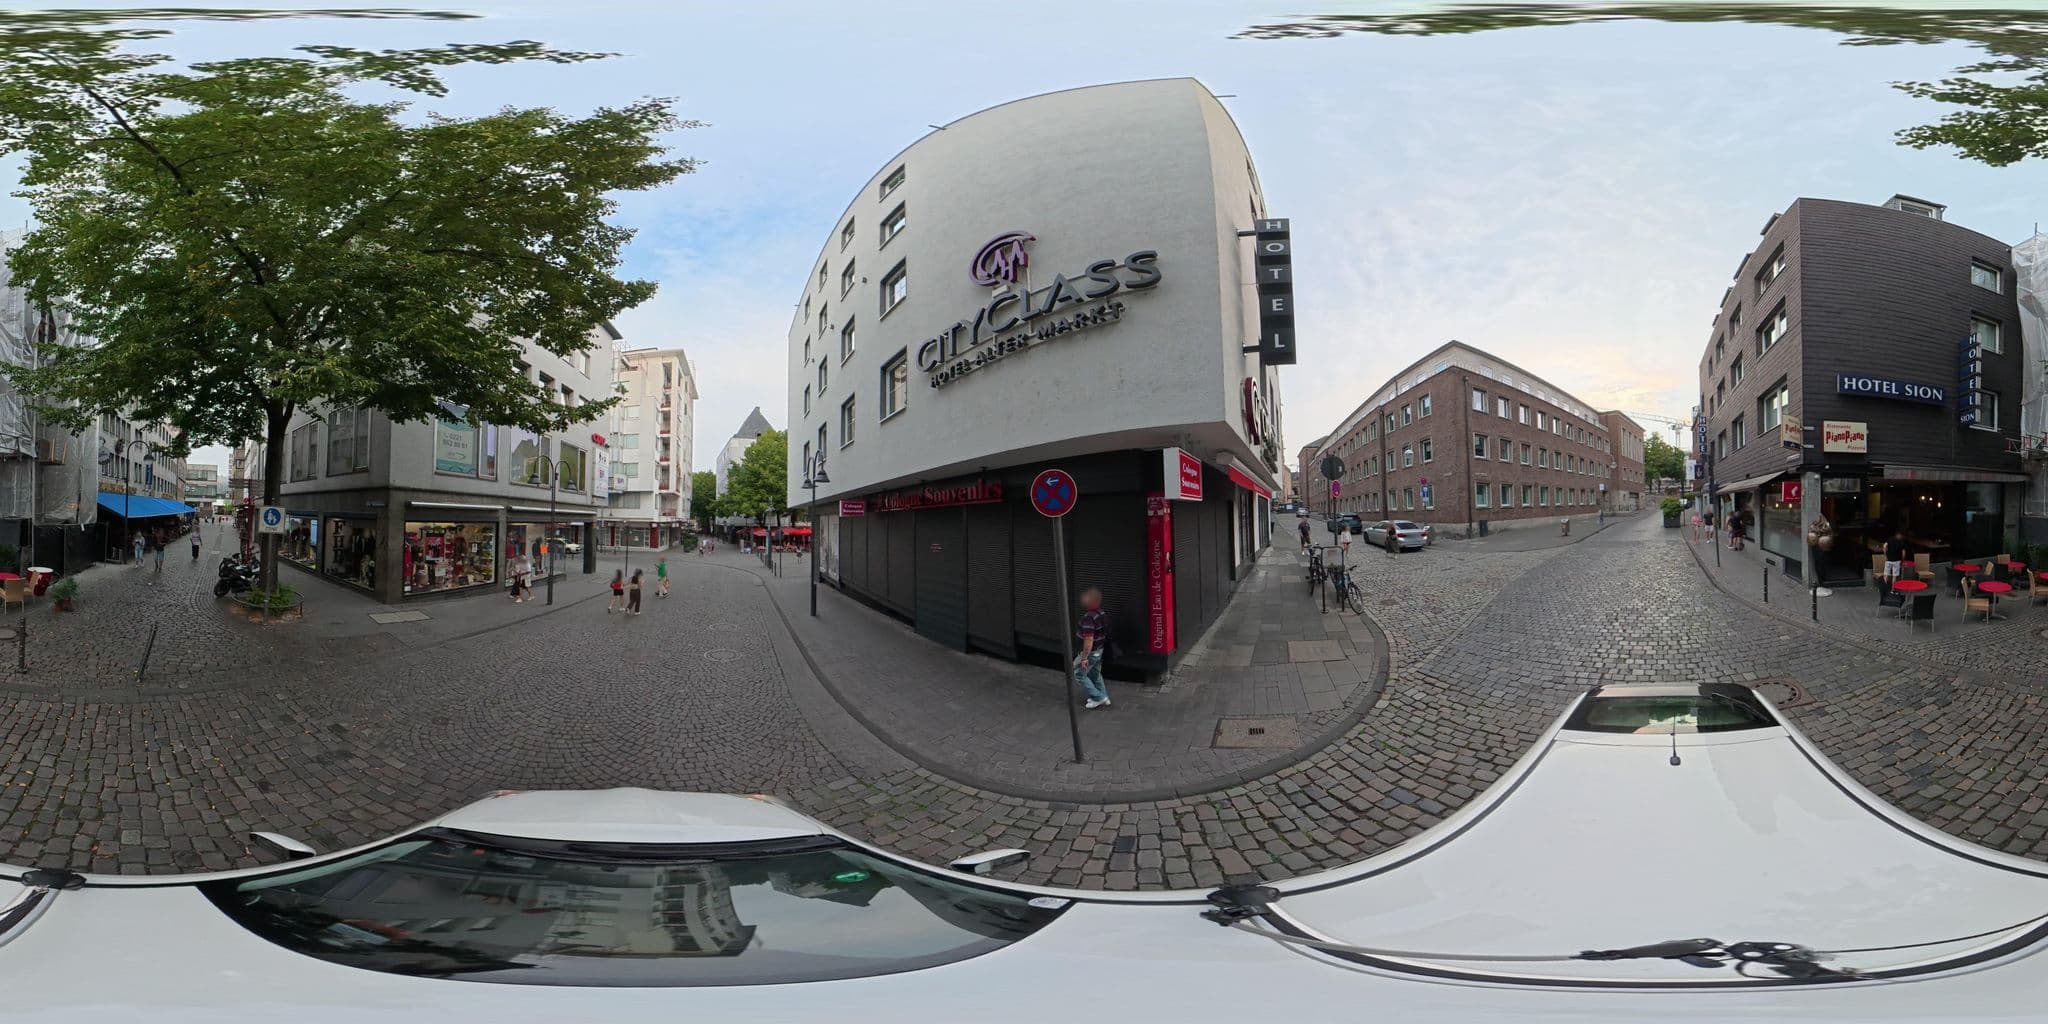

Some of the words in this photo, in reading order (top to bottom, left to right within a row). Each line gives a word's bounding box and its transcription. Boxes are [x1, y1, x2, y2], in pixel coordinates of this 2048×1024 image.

[1265, 221, 1285, 349] HOTEL
[915, 250, 1162, 372] CITYCLASS
[930, 358, 972, 389] HOTEL
[1037, 301, 1125, 341] MARKT
[1968, 333, 1976, 406] HOTEL
[1843, 377, 1900, 395] HOTEL
[1904, 383, 1943, 401] SION
[1960, 413, 1975, 424] SION
[924, 478, 1003, 505] Souvenirs
[1152, 539, 1162, 579] Cologne
[1152, 581, 1161, 592] de
[1152, 594, 1162, 610] Eau
[1152, 613, 1163, 649] Original
